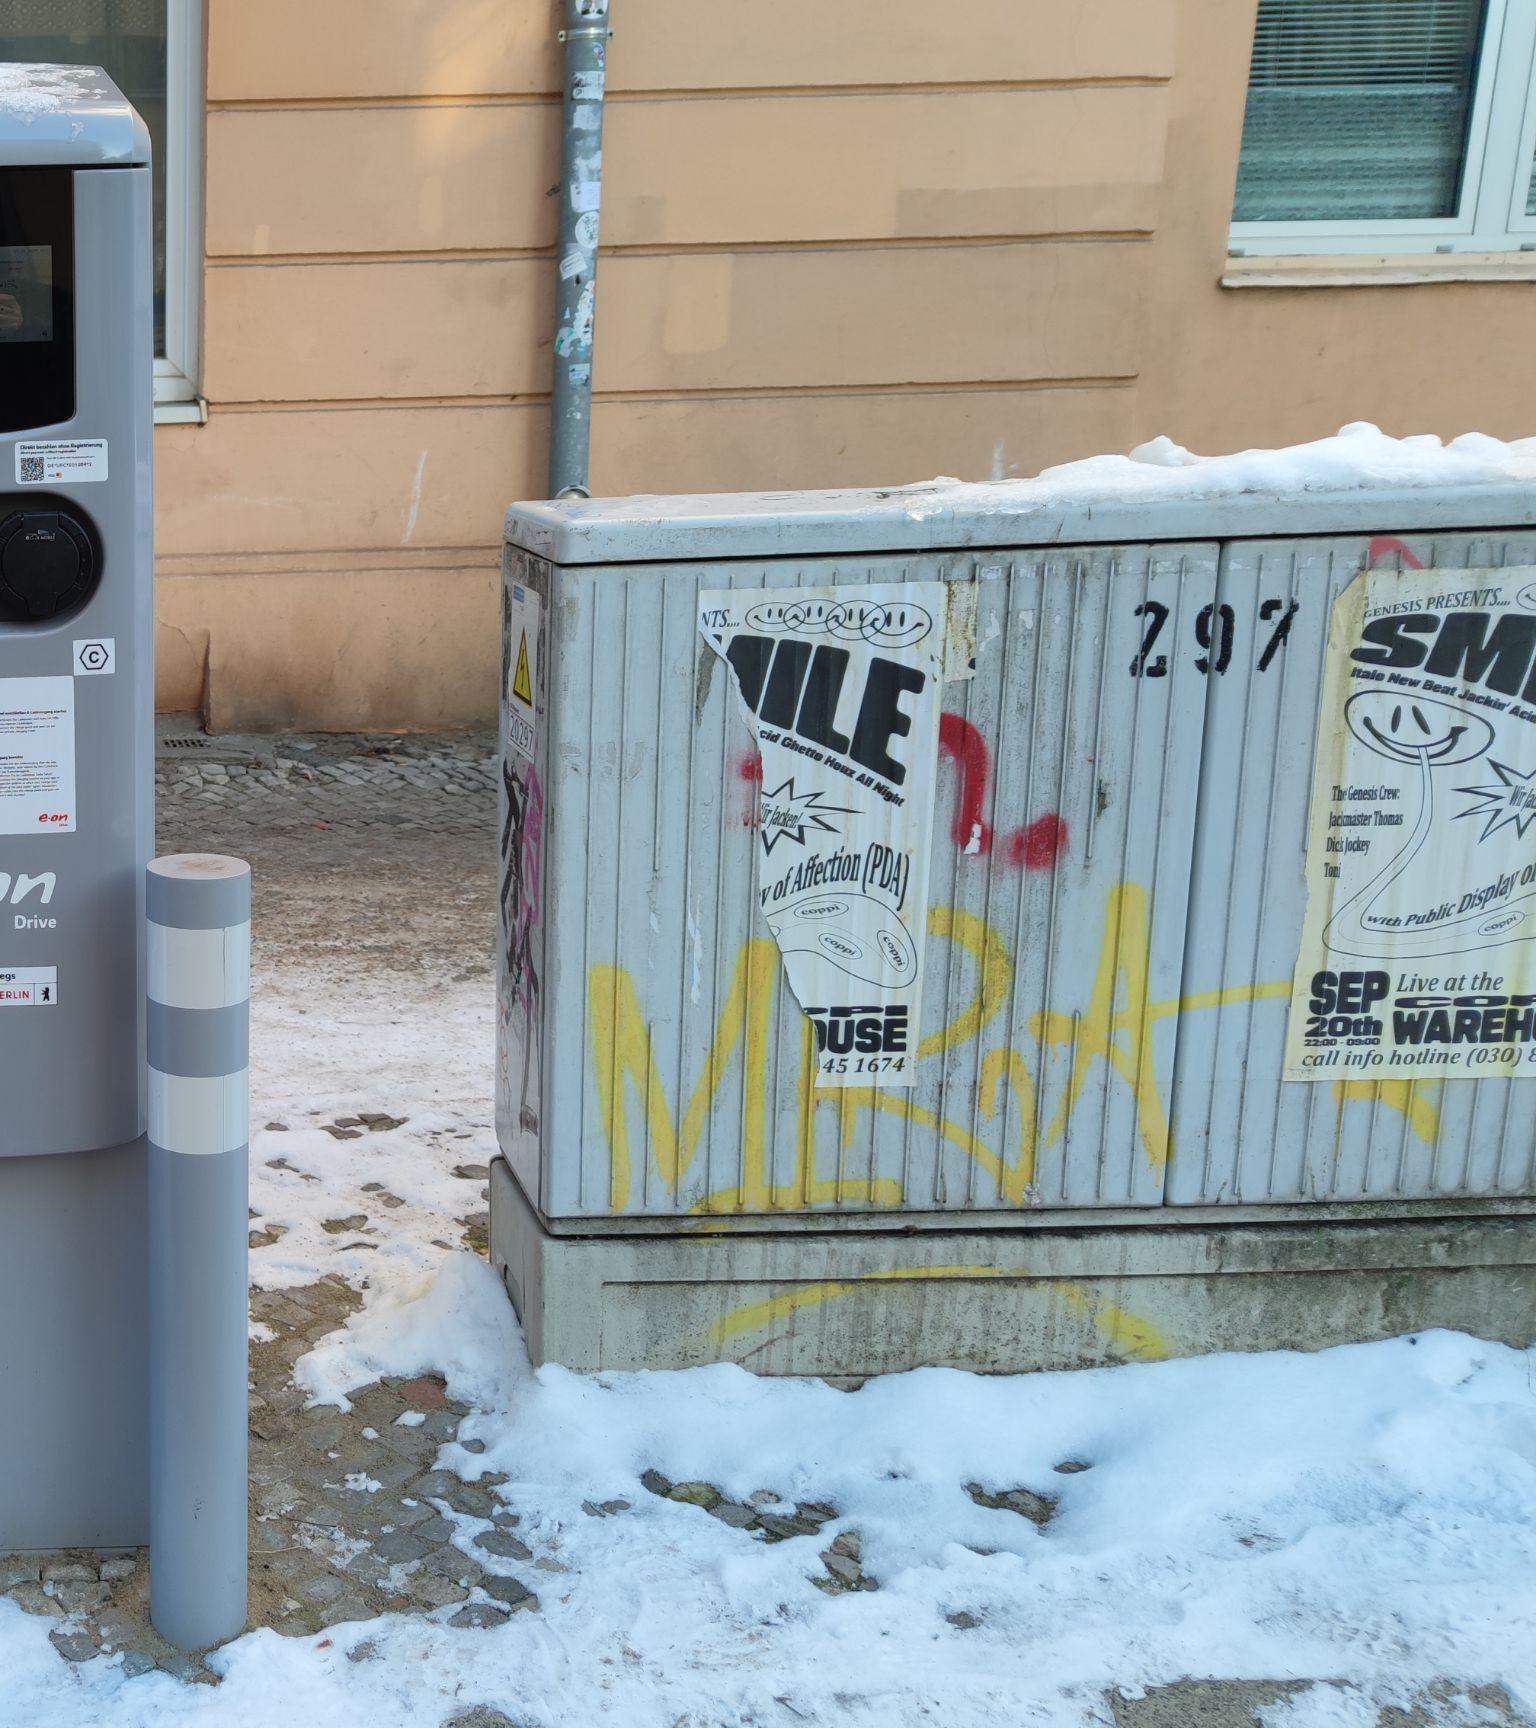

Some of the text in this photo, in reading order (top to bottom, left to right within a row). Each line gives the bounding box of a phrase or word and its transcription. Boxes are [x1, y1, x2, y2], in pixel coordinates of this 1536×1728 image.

[1363, 598, 1423, 618] GENESIS
[1129, 597, 1300, 677] 297
[1350, 612, 1536, 705] SM
[1350, 667, 1386, 682] Italo
[1387, 672, 1421, 688] New
[1421, 679, 1457, 697] Beat
[1457, 689, 1510, 712] Jackin'
[510, 714, 533, 752] 20297
[758, 727, 906, 807] cid Ghetto Houz All Night
[1332, 785, 1347, 801] The
[1348, 785, 1378, 801] Genesis
[1509, 784, 1527, 807] Wir
[767, 805, 803, 829] Jacken!
[1328, 810, 1404, 830] Jackmaster Thomas
[1326, 836, 1371, 856] Dick Jockey
[773, 866, 794, 901] of
[790, 845, 861, 895] Affection
[861, 842, 910, 911] (PDA)
[1324, 862, 1341, 878] Toni
[1367, 915, 1402, 927] with
[1404, 901, 1458, 927] Public
[1457, 869, 1521, 915] Display
[800, 903, 841, 916] coppi
[14, 914, 57, 929] Drive
[1483, 915, 1518, 933] coppi
[824, 936, 857, 957] coppi
[882, 935, 906, 967] coppi
[1309, 970, 1391, 1016] SEP
[1396, 971, 1504, 993] Live at the
[1304, 1016, 1383, 1038] 20th
[1393, 1008, 1536, 1045] WAREH
[1304, 1038, 1338, 1047] 22:00
[1346, 1037, 1381, 1046] 09:00
[823, 1057, 906, 1074] 45 1674
[1302, 1050, 1340, 1067] call
[1344, 1049, 1384, 1070] info
[1389, 1048, 1462, 1066] hotline
[1465, 1047, 1523, 1069] (030)
